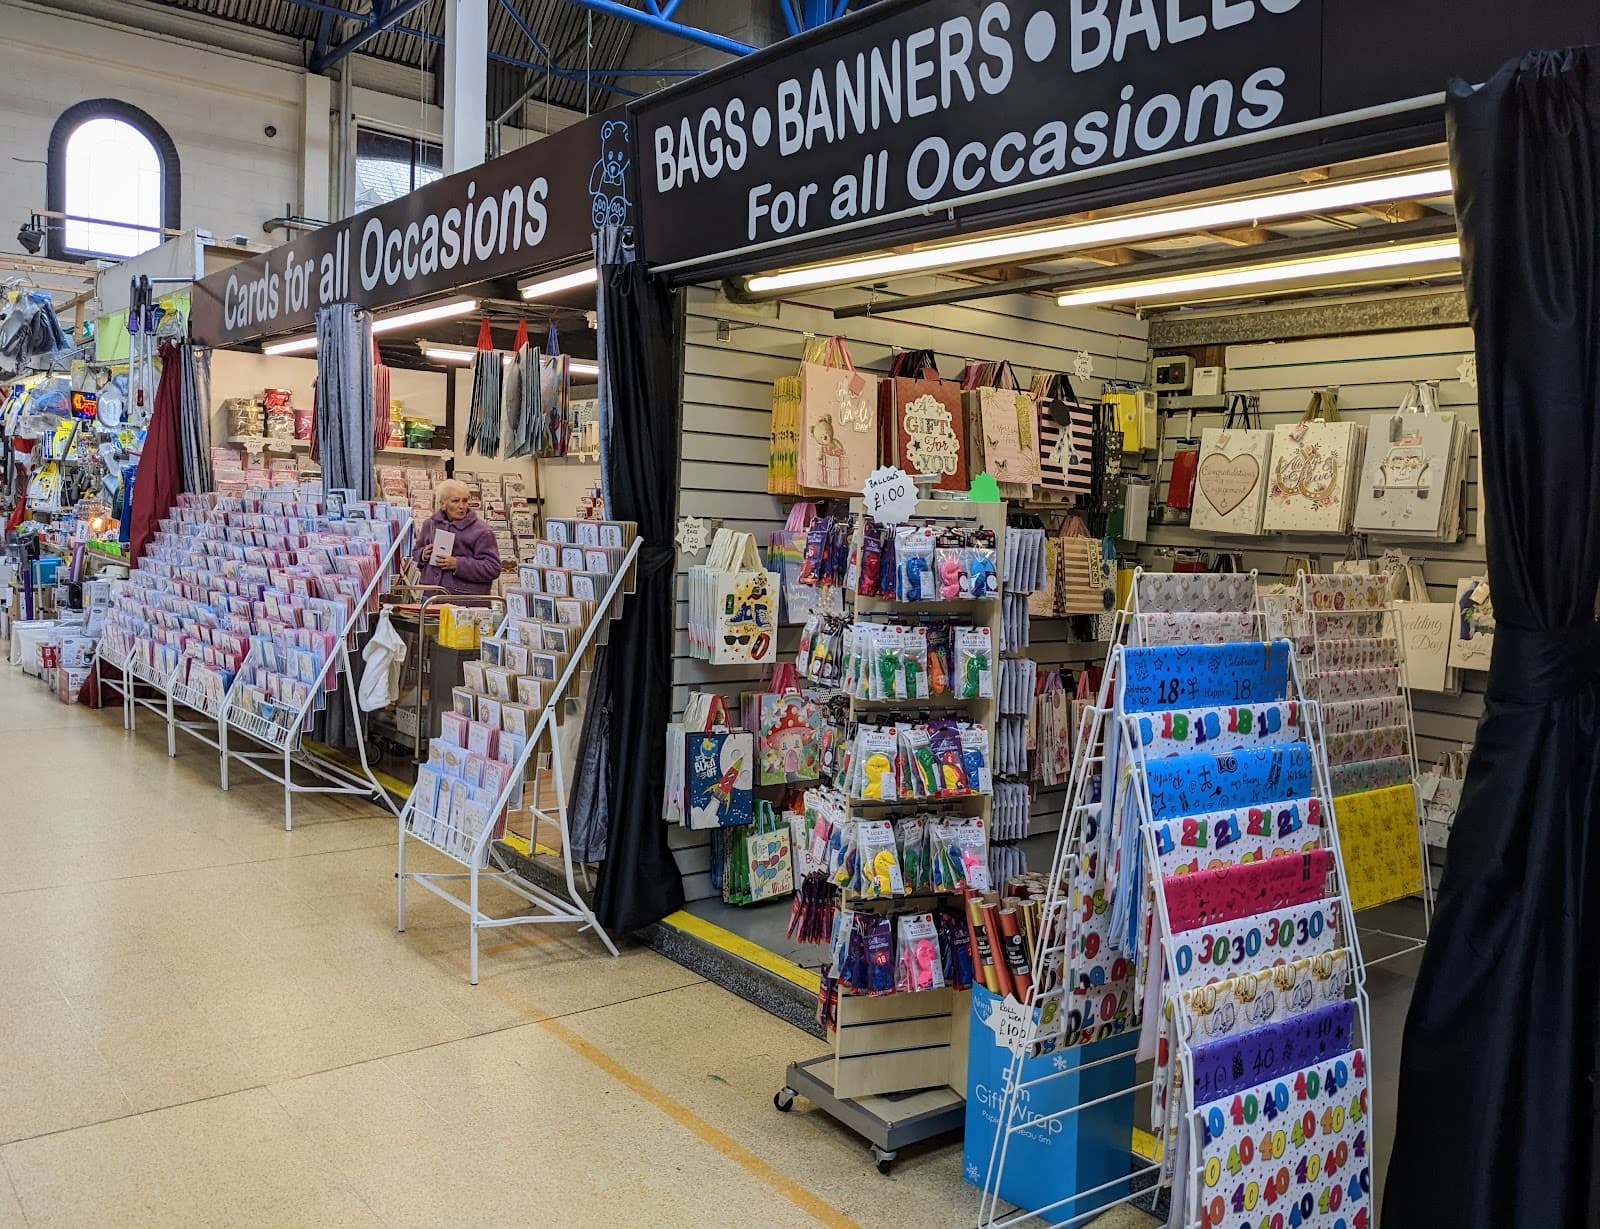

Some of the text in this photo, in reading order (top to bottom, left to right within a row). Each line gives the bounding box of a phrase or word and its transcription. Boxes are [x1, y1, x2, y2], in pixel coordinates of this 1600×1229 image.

[655, 98, 747, 192] BAGS
[778, 2, 1013, 156] BANNERS
[748, 67, 1286, 240] For all Occasions
[224, 176, 548, 331] Cards for all Occasions
[905, 415, 949, 436] GIFT
[919, 454, 957, 472] YOU
[1411, 634, 1443, 654] Day
[1157, 678, 1179, 704] 18
[1232, 678, 1251, 700] 18
[1161, 711, 1189, 741] 18
[1194, 711, 1221, 745] 18
[1227, 707, 1253, 735] 18
[1257, 707, 1282, 738] 18
[1181, 818, 1208, 848] 21
[1214, 813, 1242, 850] 21
[1247, 808, 1272, 837] 21
[1277, 804, 1303, 839] 21
[1198, 934, 1230, 965] 30
[1232, 928, 1261, 964] 30
[1265, 918, 1294, 947] 30
[1297, 910, 1324, 945] 30
[1253, 1048, 1274, 1075] 40
[975, 1084, 1004, 1112] Gift
[1230, 1094, 1258, 1125] 40
[1264, 1082, 1289, 1122] 40
[1294, 1071, 1320, 1100] 40
[1324, 1060, 1348, 1098] 40
[1010, 1100, 1063, 1135] Wrap
[1226, 1136, 1254, 1176] 40
[1259, 1130, 1286, 1161] 40
[1291, 1110, 1316, 1149] 40
[1320, 1105, 1345, 1135] 40
[1231, 1181, 1259, 1213] 40
[1264, 1167, 1289, 1206] 40
[1295, 1154, 1320, 1184] 40
[1324, 1140, 1348, 1177] 40
[1288, 1192, 1314, 1229] 40
[1318, 1184, 1343, 1214] 40
